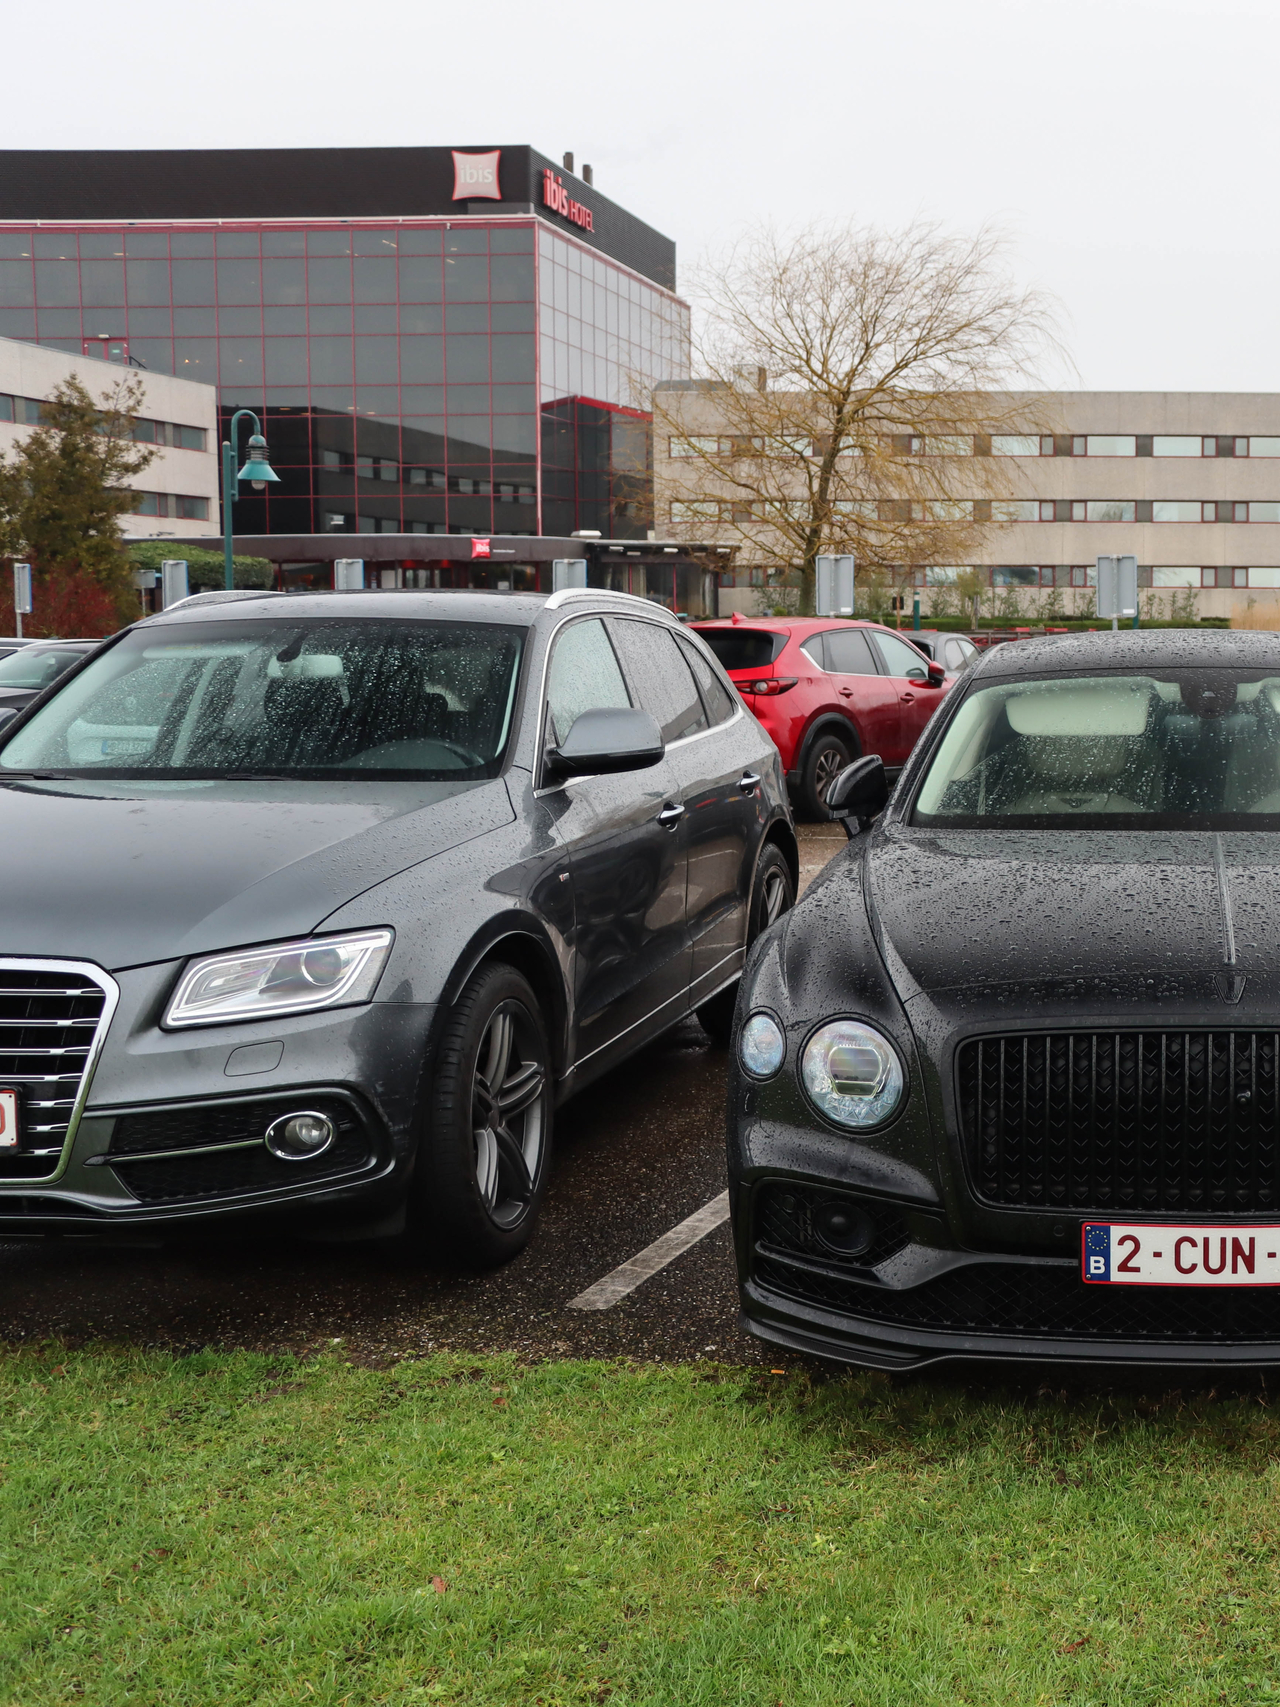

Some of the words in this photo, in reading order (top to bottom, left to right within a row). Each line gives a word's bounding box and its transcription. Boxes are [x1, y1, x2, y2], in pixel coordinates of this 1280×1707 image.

[460, 164, 494, 183] ibis
[543, 168, 569, 217] ibis
[568, 199, 595, 233] HOTEL
[476, 543, 490, 552] ibis
[1090, 1256, 1106, 1274] B
